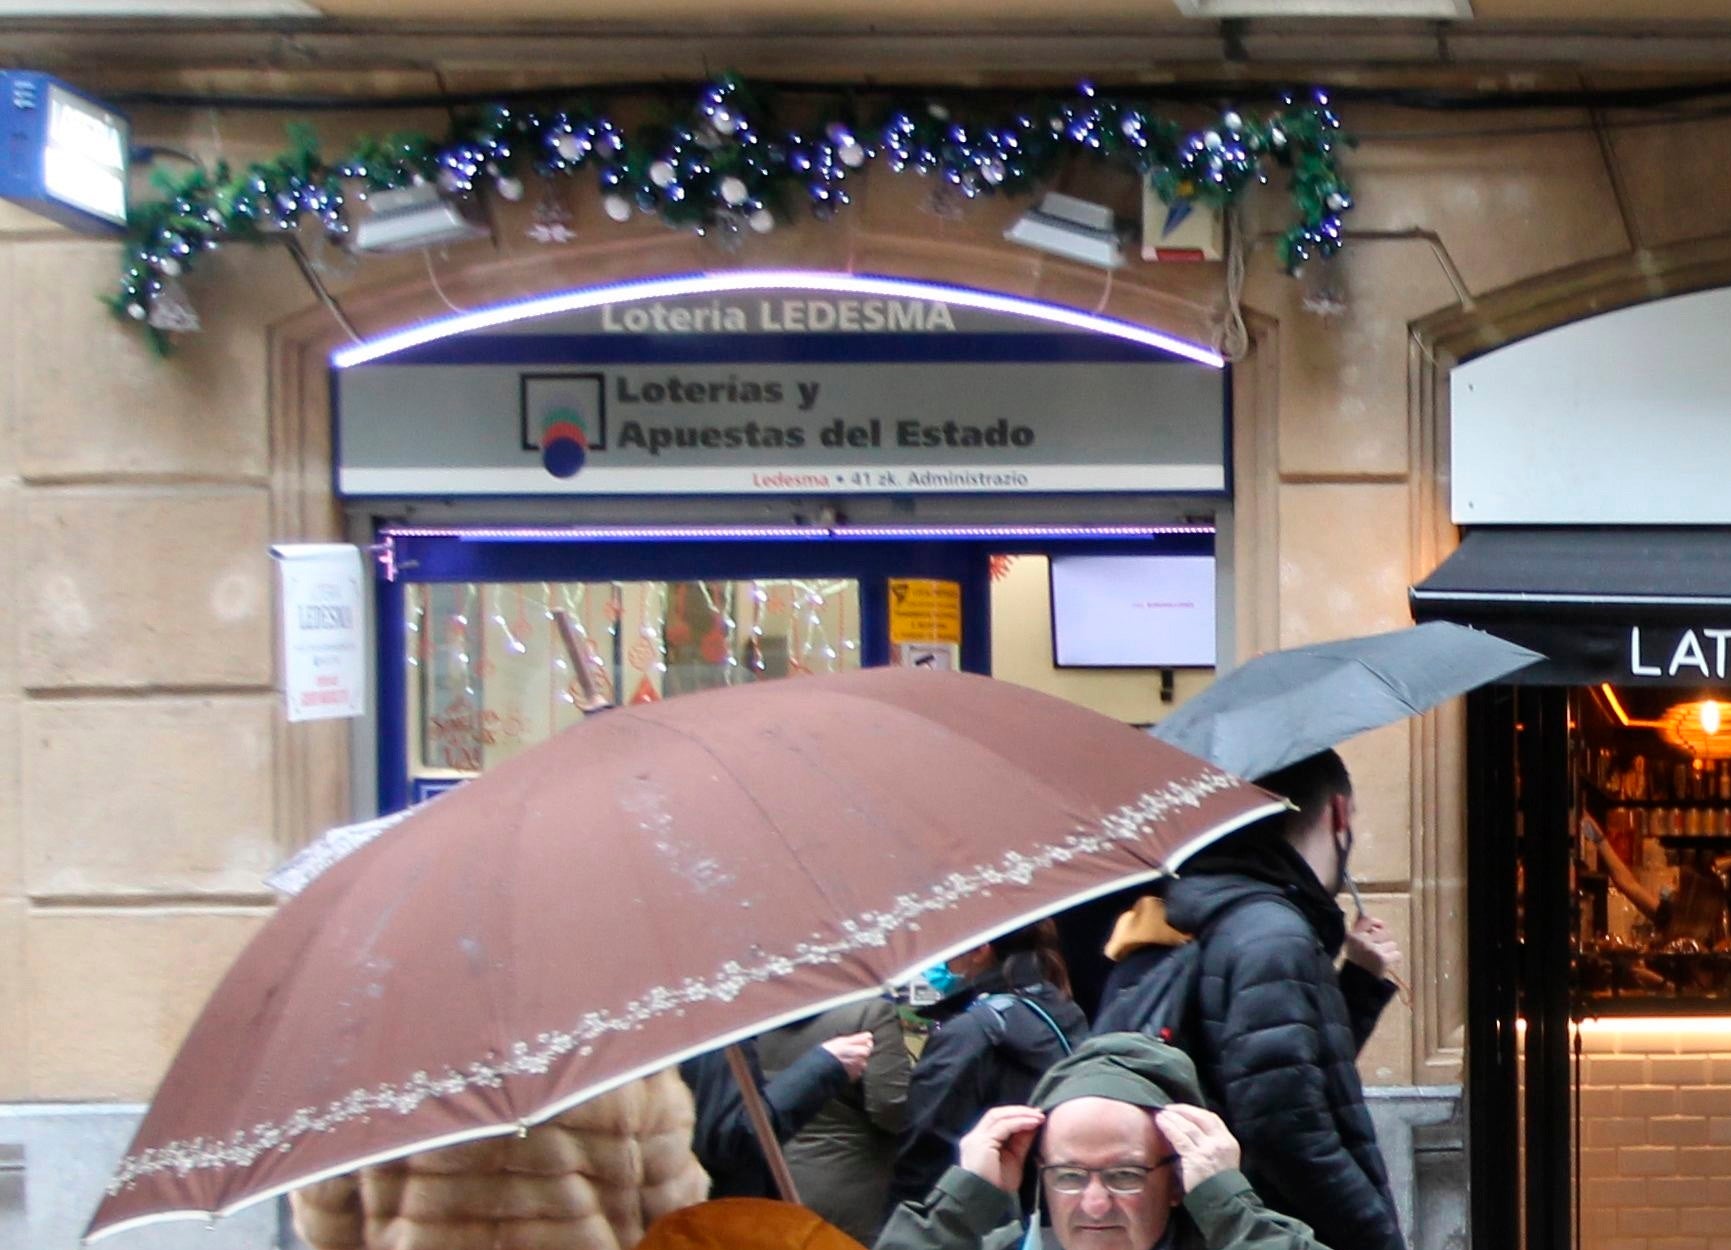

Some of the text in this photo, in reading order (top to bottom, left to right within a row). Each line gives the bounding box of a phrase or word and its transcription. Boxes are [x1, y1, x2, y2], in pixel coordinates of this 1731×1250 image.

[759, 300, 956, 332] LEDESMA
[797, 381, 820, 411] y
[617, 419, 1036, 456] Apuestas del Estado
[752, 471, 830, 488] Ledesma
[851, 472, 872, 487] 41
[908, 470, 1029, 488] Administrazio
